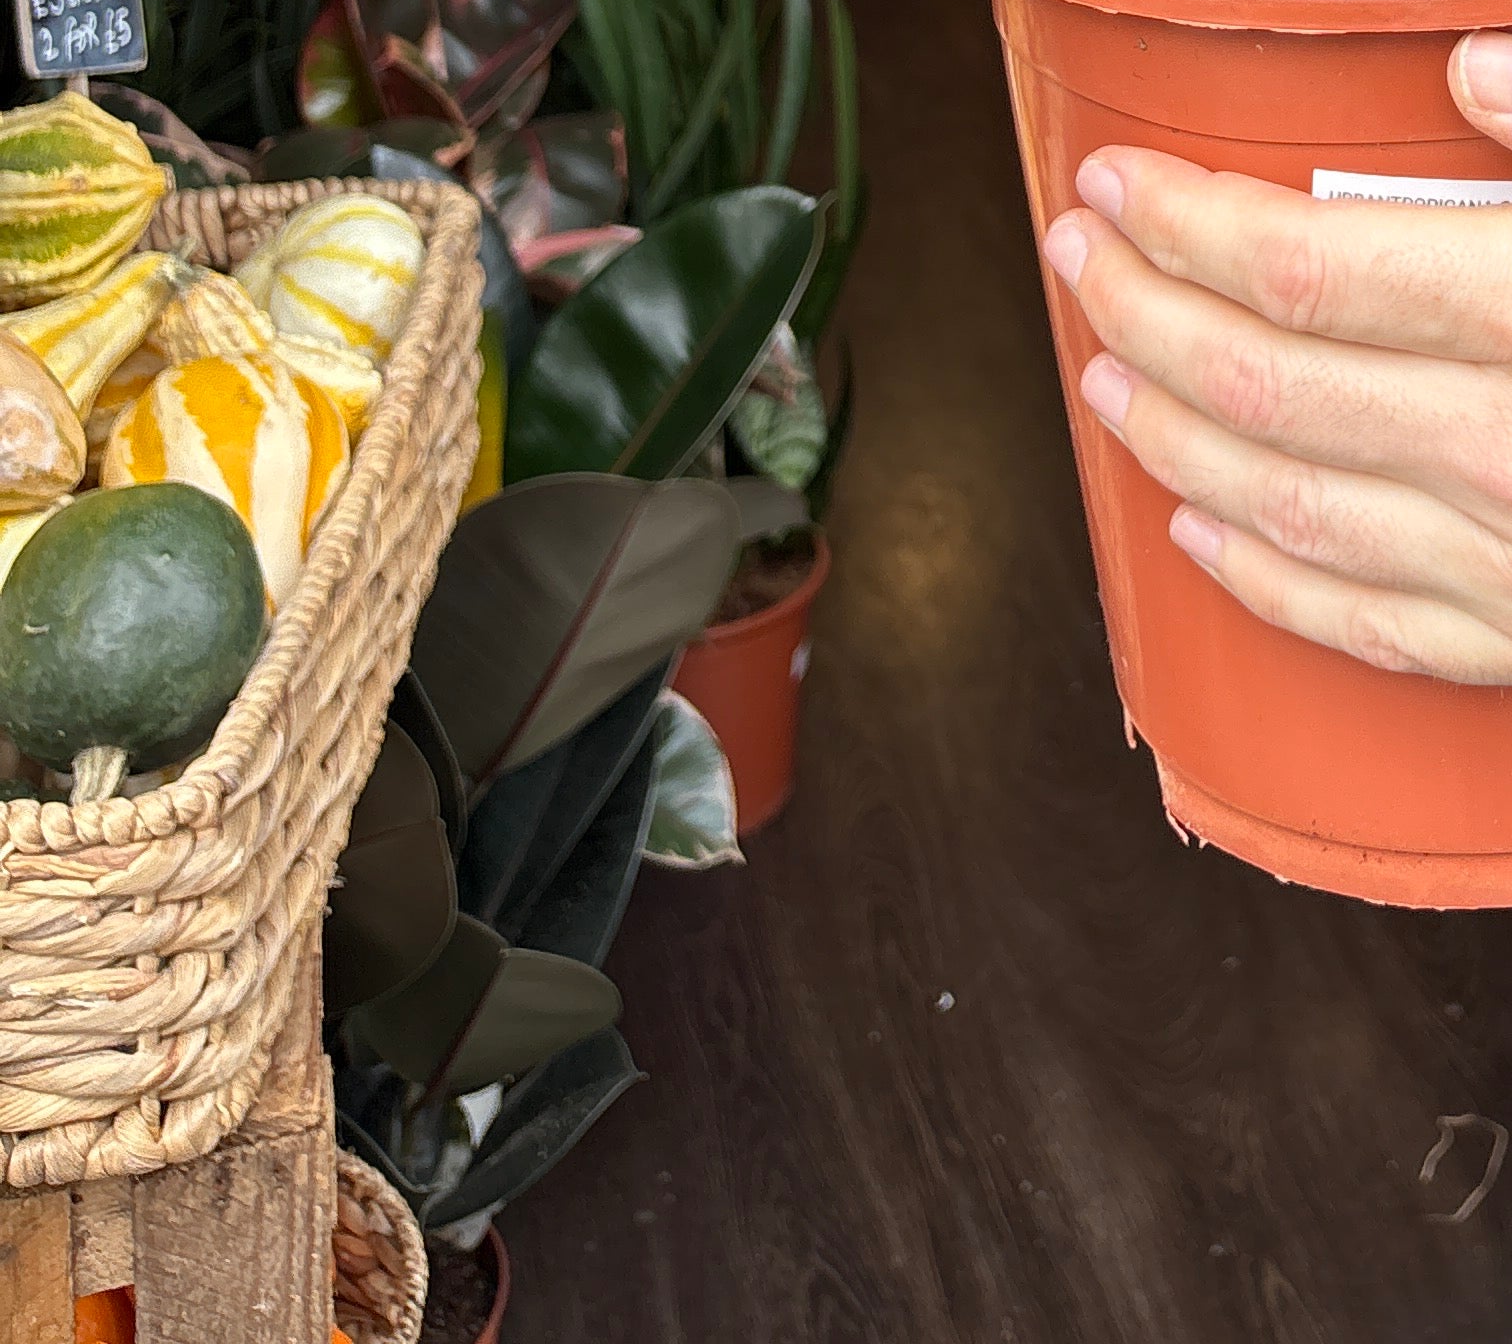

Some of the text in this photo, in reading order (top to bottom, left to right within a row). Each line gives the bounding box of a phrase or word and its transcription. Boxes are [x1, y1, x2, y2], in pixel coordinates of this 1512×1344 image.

[39, 6, 132, 62] 2 FOR £5
